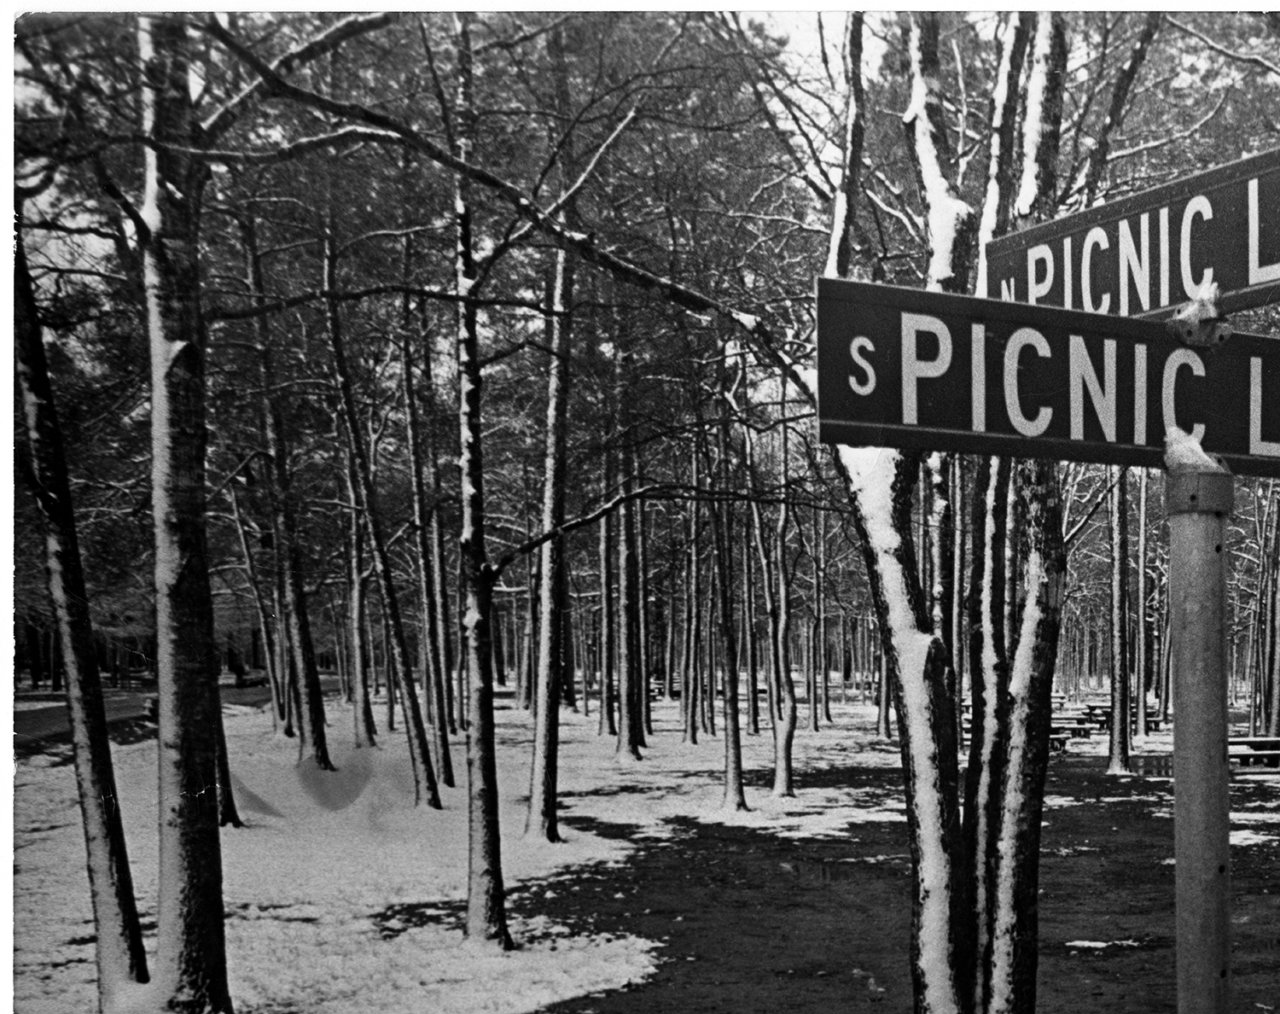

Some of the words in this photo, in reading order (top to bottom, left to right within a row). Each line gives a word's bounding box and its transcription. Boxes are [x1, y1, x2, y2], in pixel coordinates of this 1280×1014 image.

[1001, 276, 1016, 303] N
[1027, 194, 1214, 317] PICNIC
[848, 336, 877, 396] S
[900, 312, 1206, 446] PICNIC
